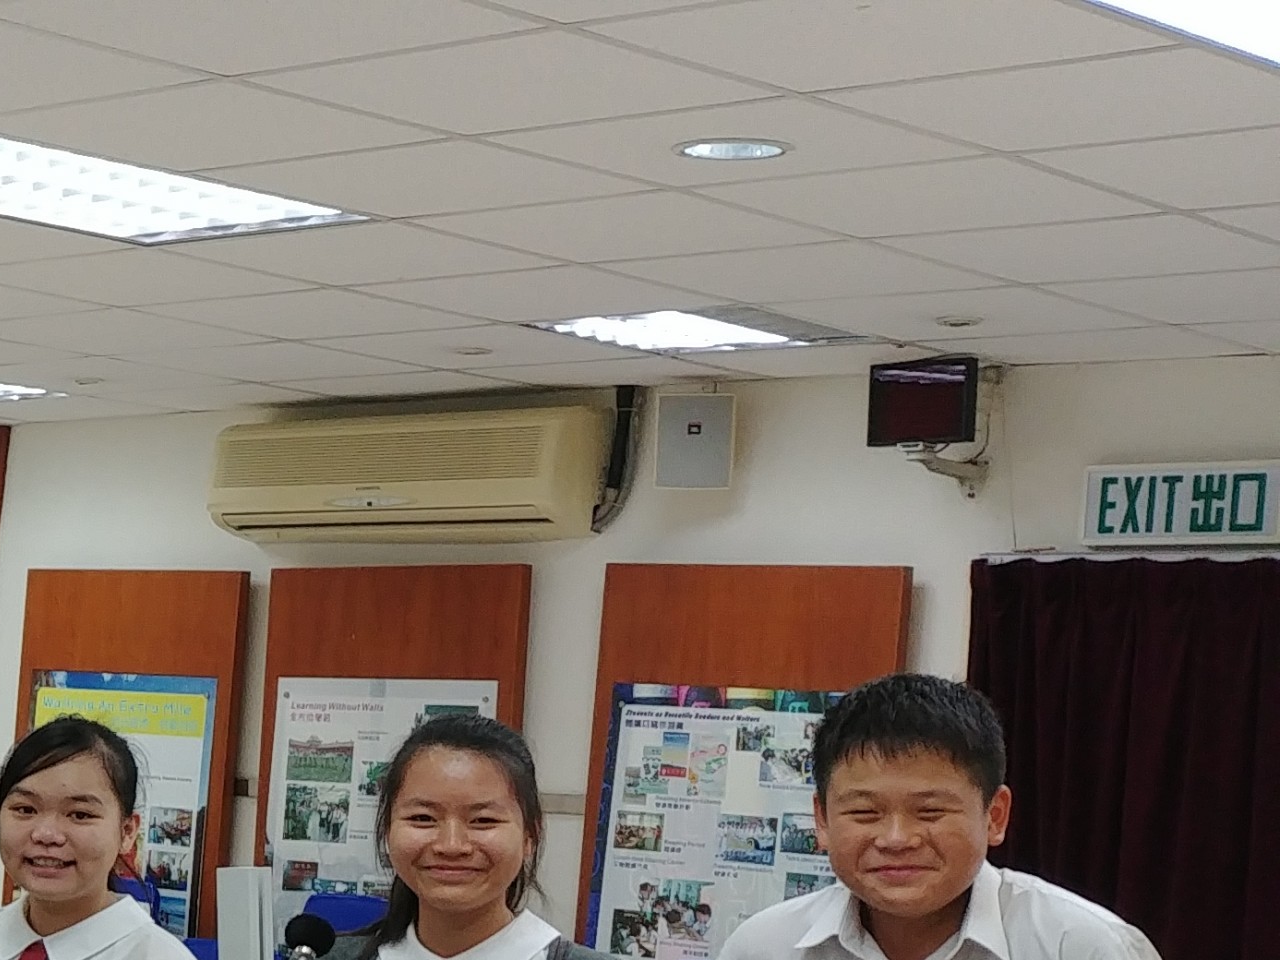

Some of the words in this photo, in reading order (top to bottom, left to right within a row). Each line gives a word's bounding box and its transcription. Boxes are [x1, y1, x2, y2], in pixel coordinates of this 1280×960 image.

[1098, 475, 1183, 534] EXIT
[1189, 473, 1268, 532] 出口
[290, 701, 327, 712] Learning
[328, 702, 361, 712] Without
[362, 702, 385, 713] Walls
